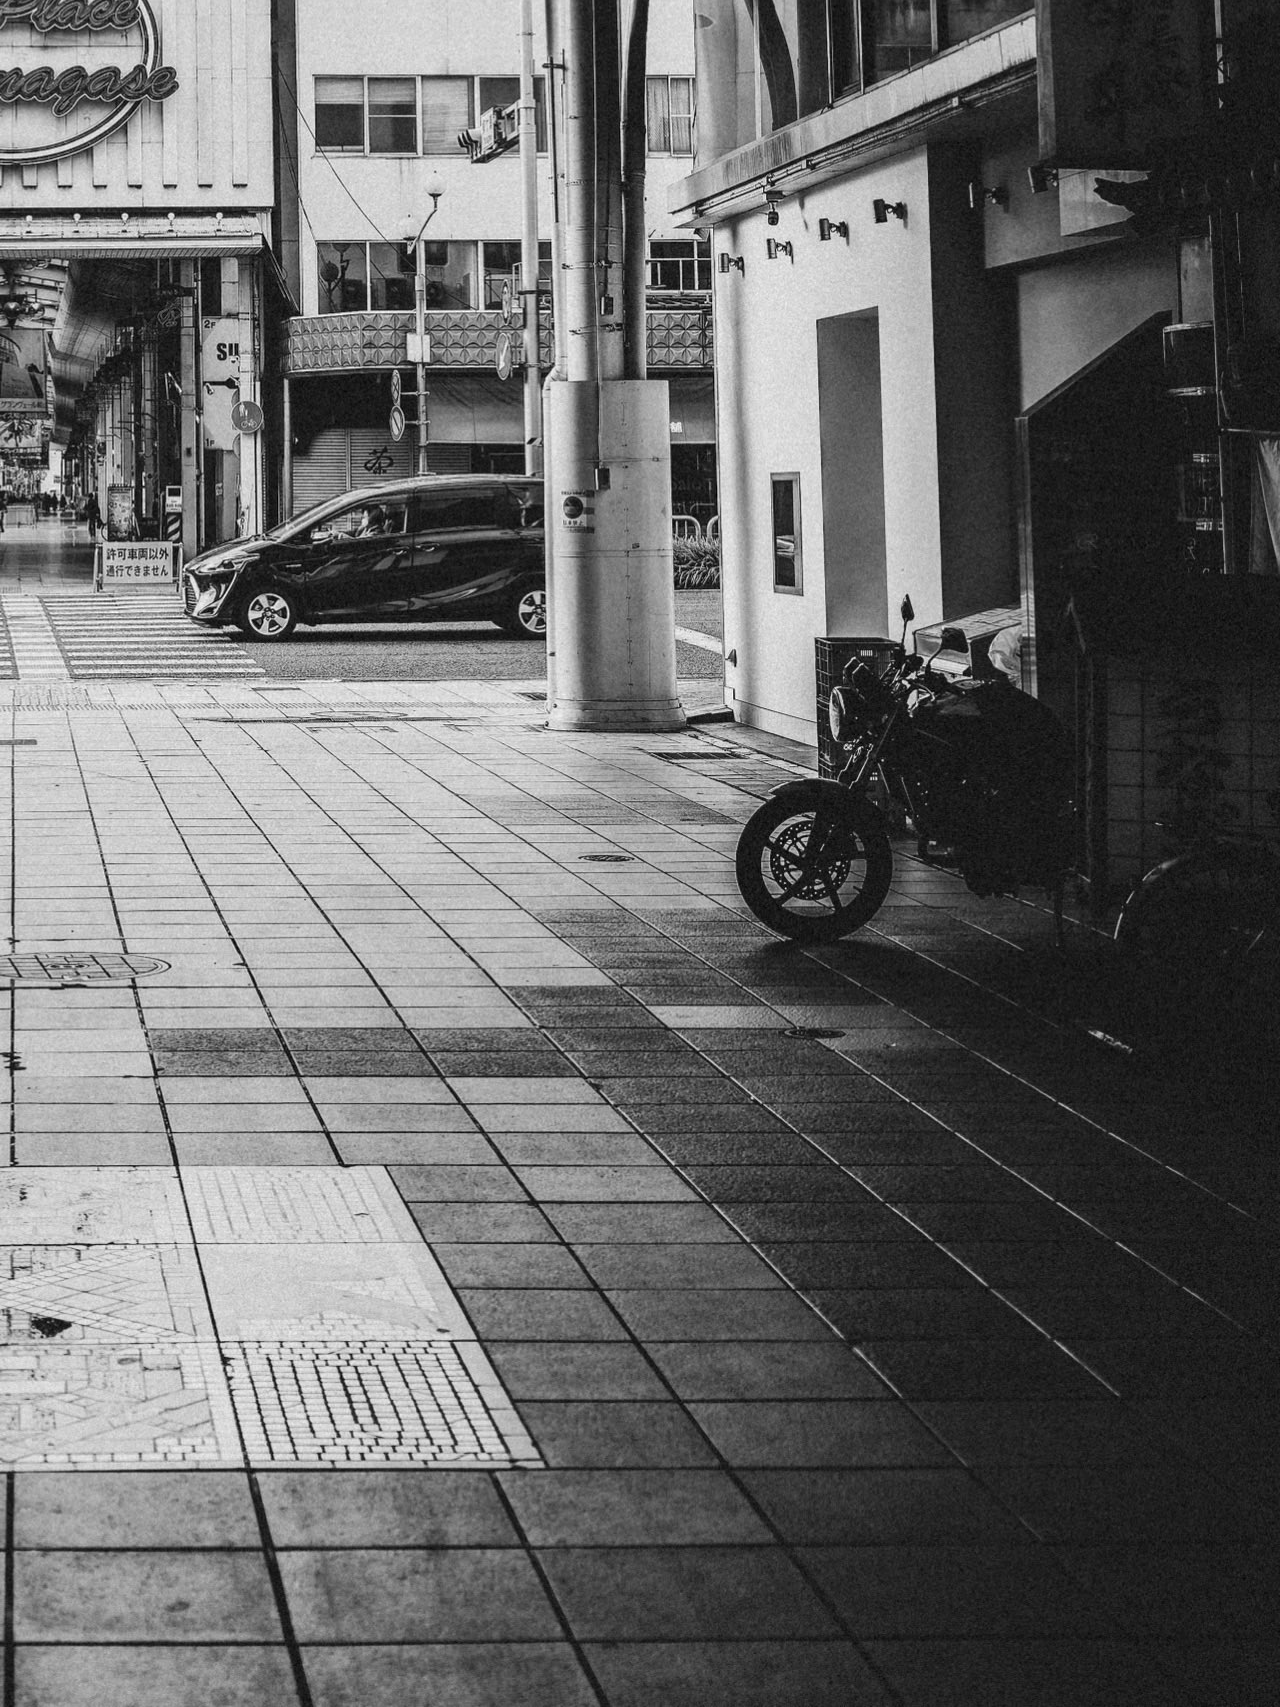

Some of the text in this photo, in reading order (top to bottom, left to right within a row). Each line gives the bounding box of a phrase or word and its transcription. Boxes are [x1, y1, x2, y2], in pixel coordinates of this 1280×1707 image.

[204, 320, 216, 329] 2F
[106, 548, 169, 560] 許可車両以外
[106, 565, 169, 577] 通行できません
